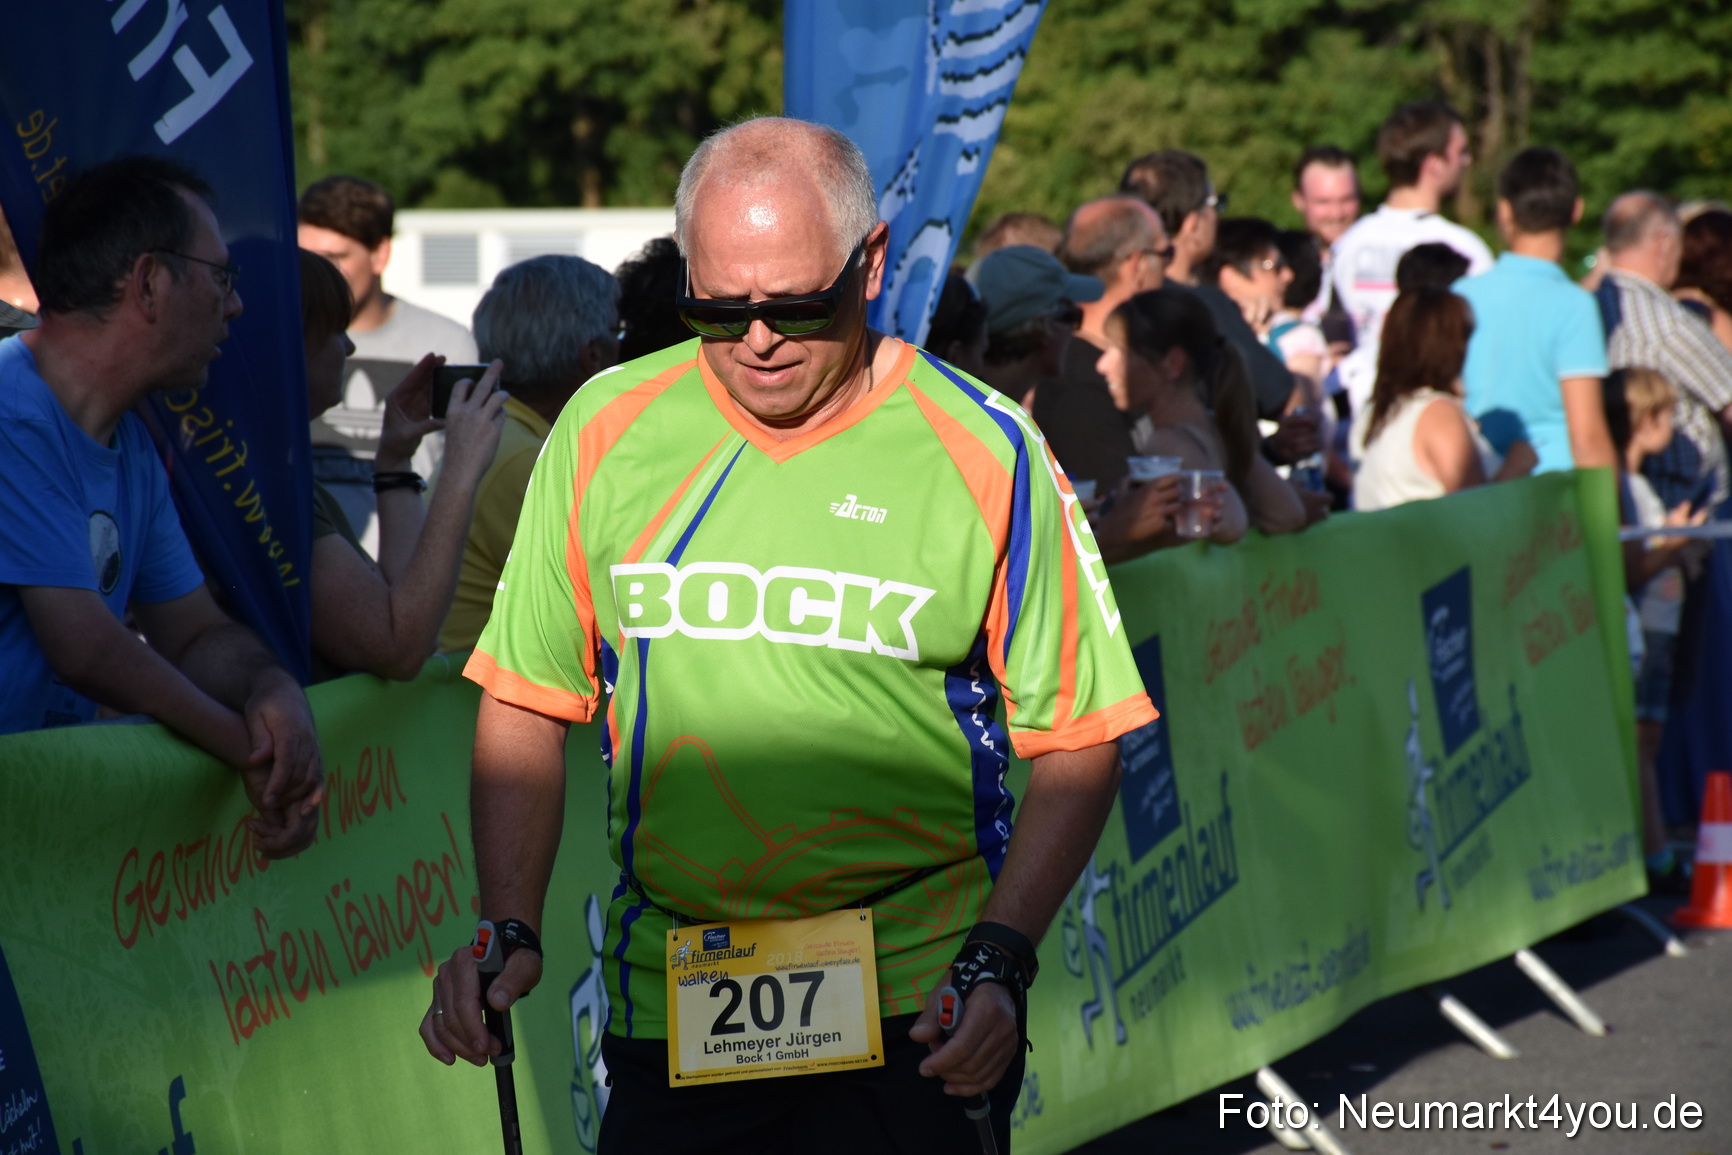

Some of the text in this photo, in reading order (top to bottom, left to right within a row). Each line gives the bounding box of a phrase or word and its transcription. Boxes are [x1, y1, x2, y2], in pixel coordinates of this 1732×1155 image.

[609, 561, 938, 662] BOCK
[691, 942, 757, 964] firmenlauf
[208, 906, 341, 1047] laufen
[677, 969, 729, 988] walken
[709, 970, 825, 1037] 207
[703, 1031, 842, 1055] Lehmeyer Jürgen
[735, 1048, 809, 1065] Bock 1 GmbH
